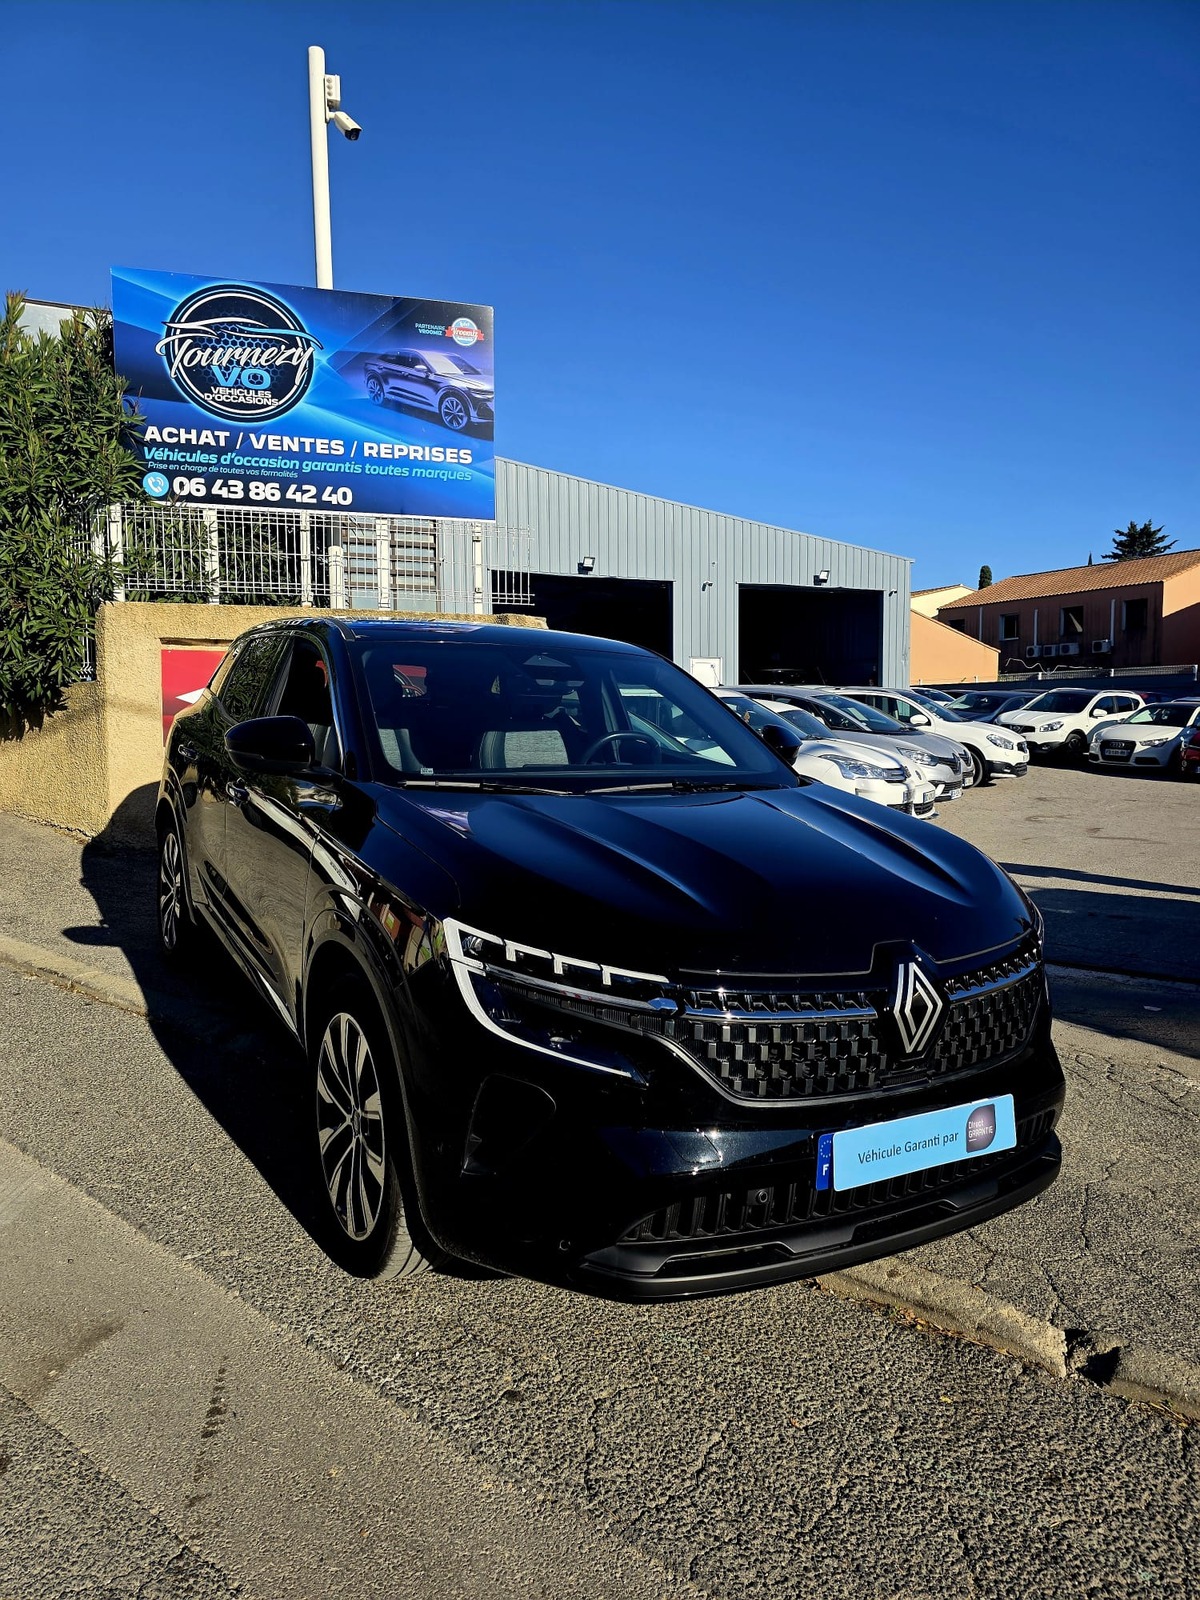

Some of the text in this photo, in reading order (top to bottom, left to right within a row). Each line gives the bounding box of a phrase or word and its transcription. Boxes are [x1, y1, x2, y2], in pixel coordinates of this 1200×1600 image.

[155, 332, 315, 387] Tournezy
[210, 365, 271, 390] VO
[204, 393, 280, 407] D'OCCASIONS
[210, 386, 272, 398] VEHICULES
[144, 426, 230, 446] ACHAT
[249, 433, 345, 456] VENTES
[363, 442, 473, 464] REPRISES
[143, 446, 472, 482] Véhicules d'occasion garantis toutes marques
[147, 461, 168, 470] Prise
[180, 463, 207, 473] charge
[208, 465, 219, 473] de
[219, 467, 245, 475] toutes
[260, 468, 299, 479] formalités
[172, 476, 353, 506] 06 43 86 42 40
[857, 1131, 959, 1165] Véhicule Garanti par
[822, 1164, 829, 1176] F
